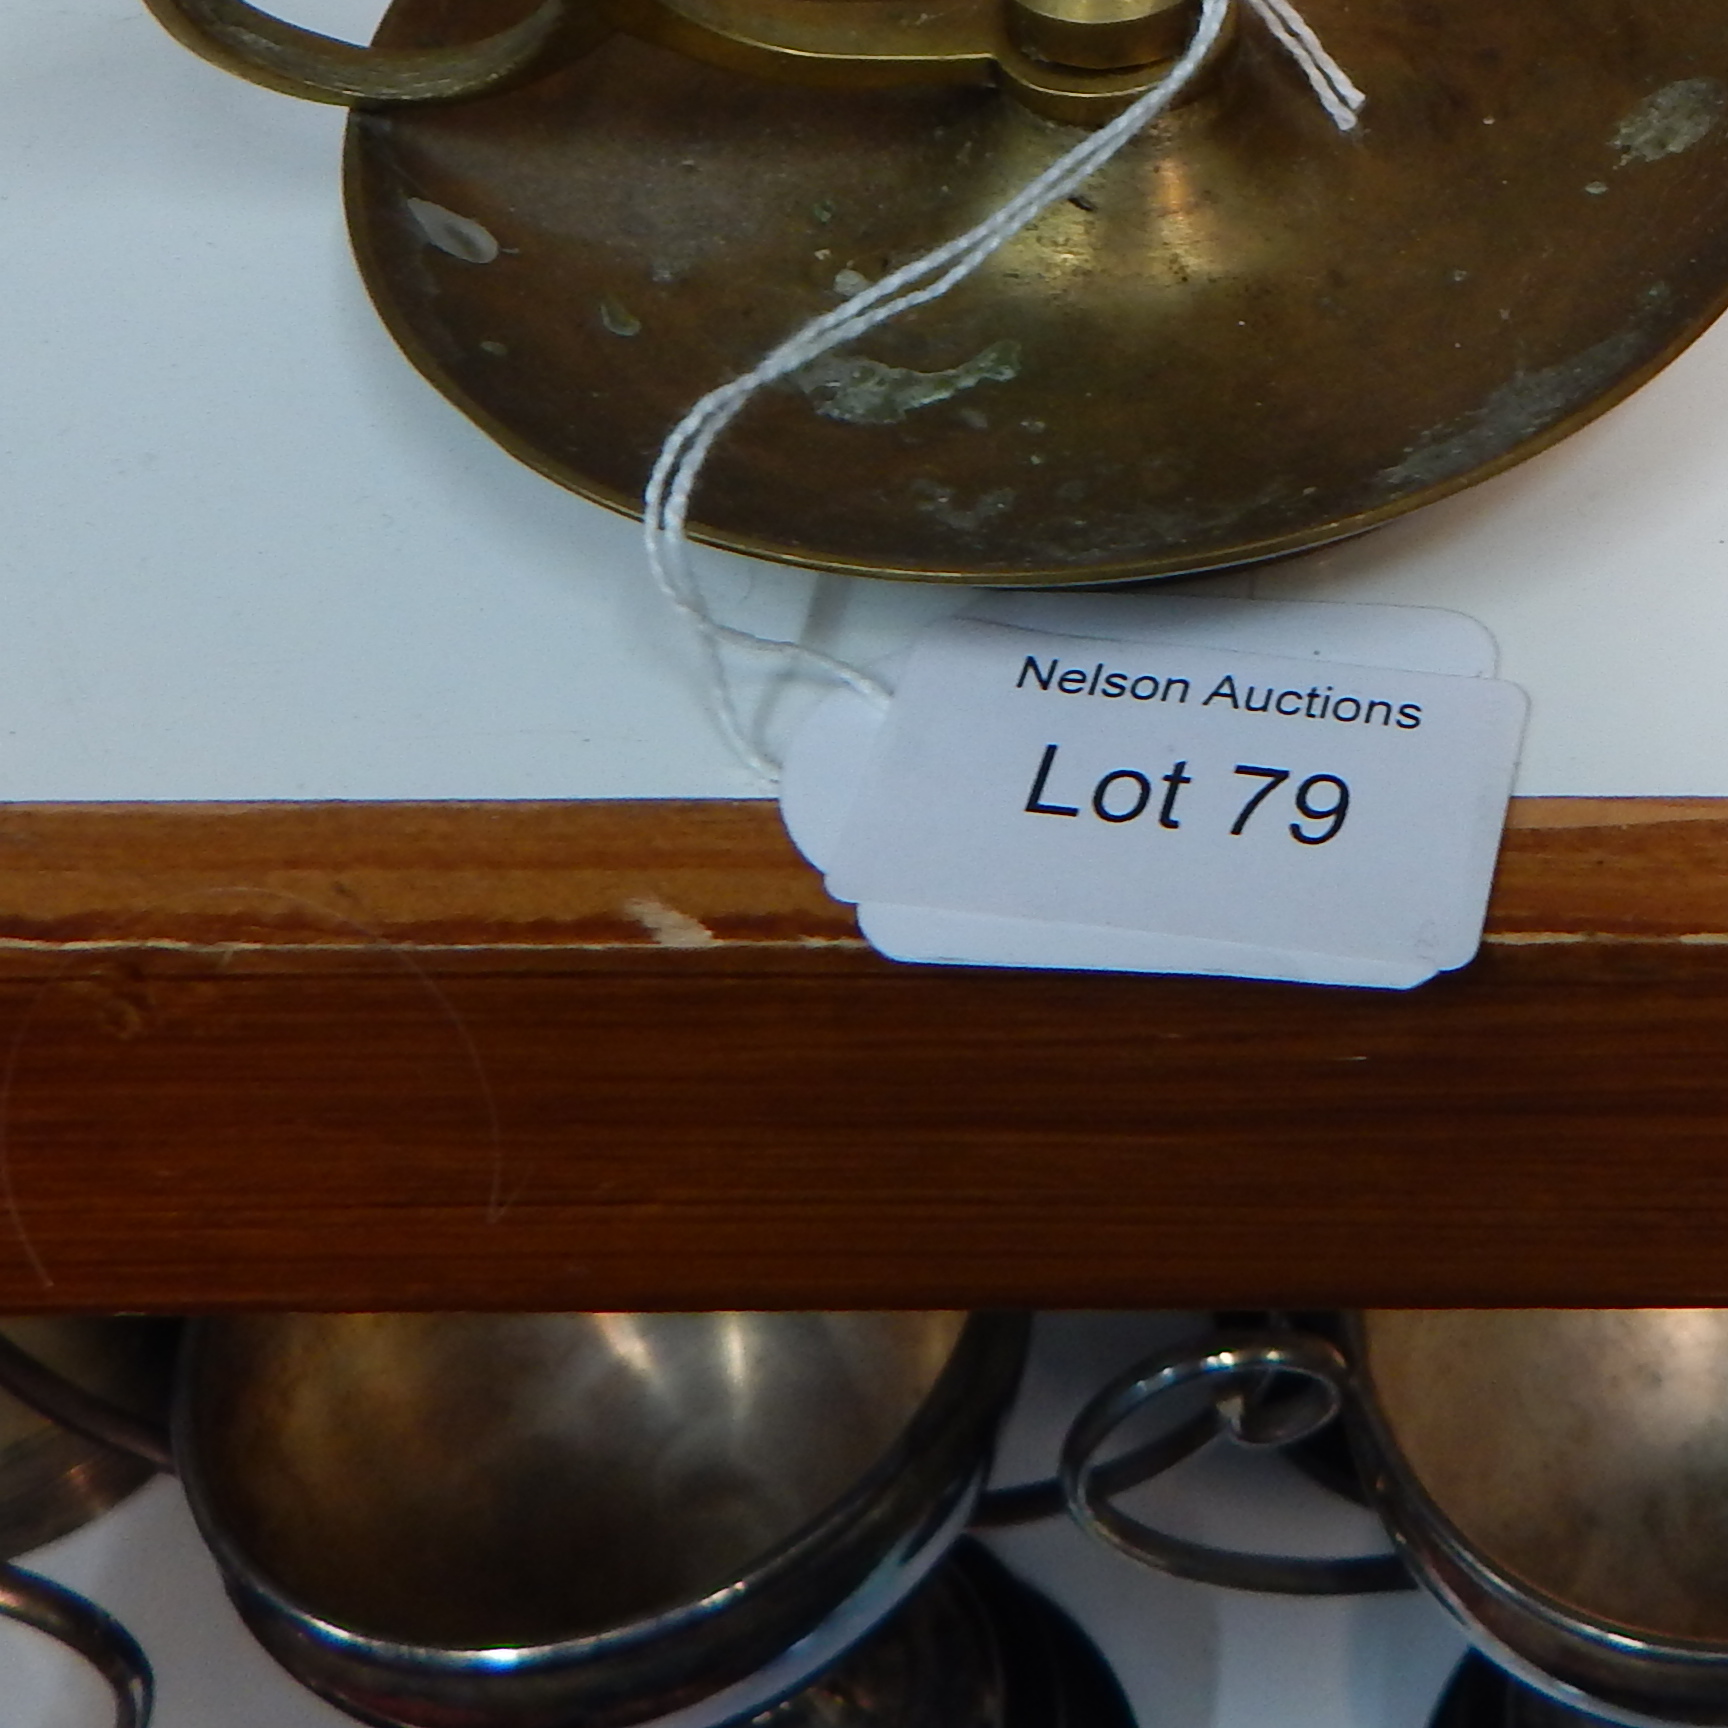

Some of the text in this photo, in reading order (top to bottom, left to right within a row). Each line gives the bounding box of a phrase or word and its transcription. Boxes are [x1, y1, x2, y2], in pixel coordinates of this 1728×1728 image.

[1015, 655, 1422, 730] Nelson Auctions
[1024, 744, 1351, 846] Lot 79
